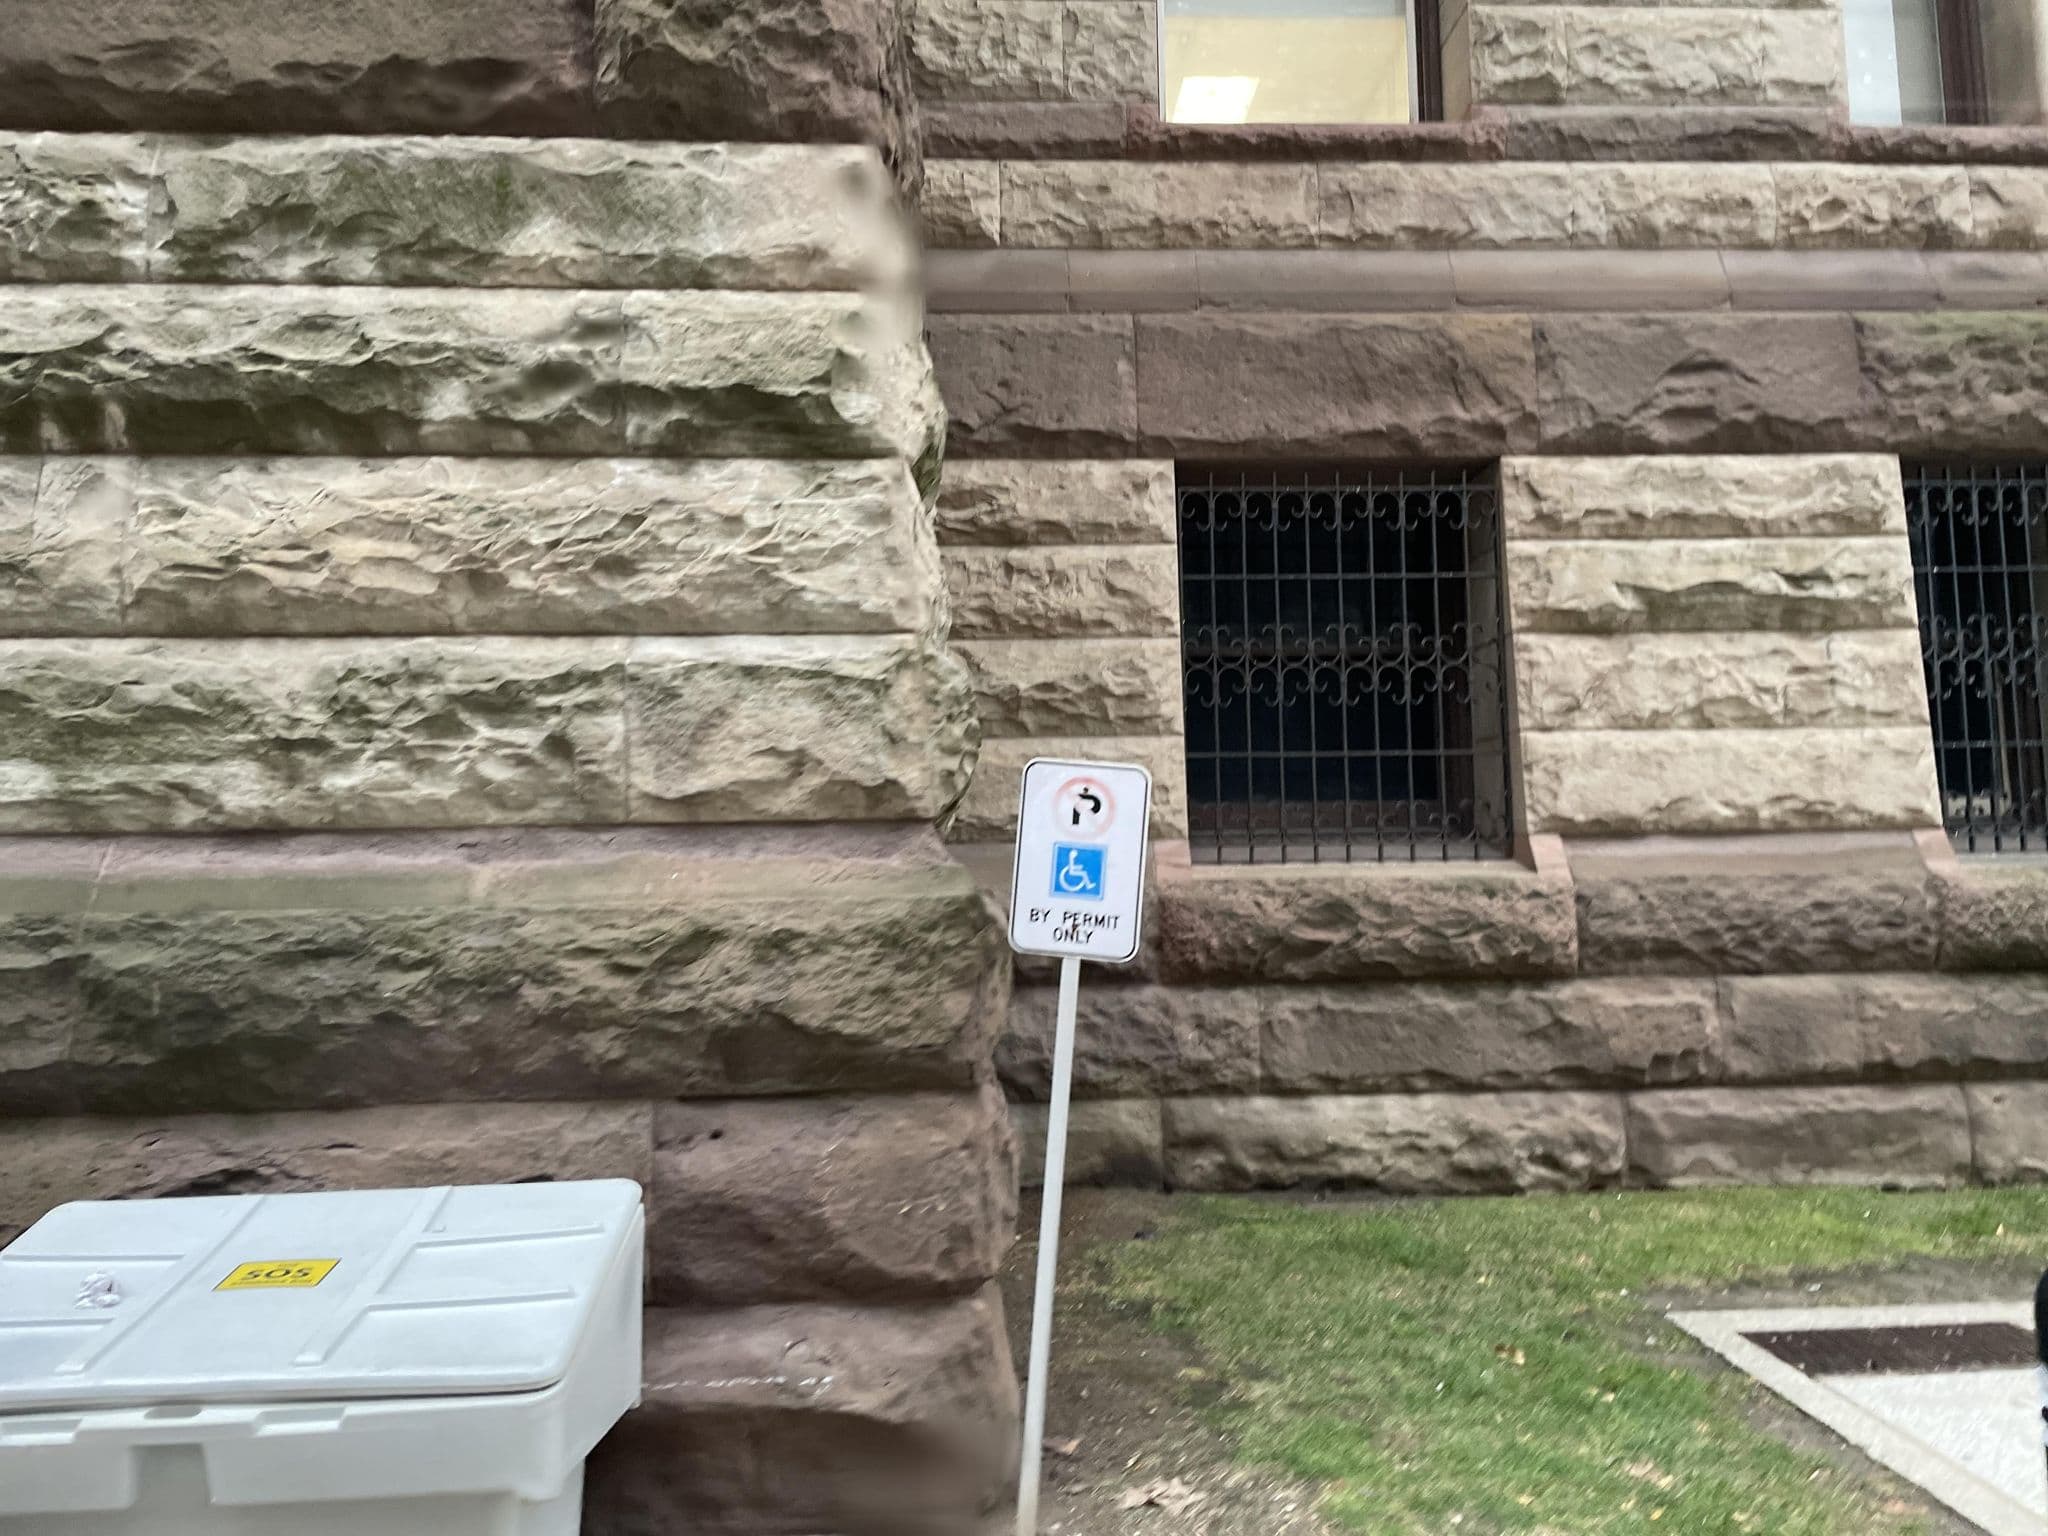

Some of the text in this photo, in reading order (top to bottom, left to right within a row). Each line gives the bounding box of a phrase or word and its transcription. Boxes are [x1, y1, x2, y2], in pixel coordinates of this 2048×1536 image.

[1030, 908, 1120, 929] BY PERMIT
[1053, 927, 1093, 944] ONLY
[242, 1267, 313, 1280] SOS
